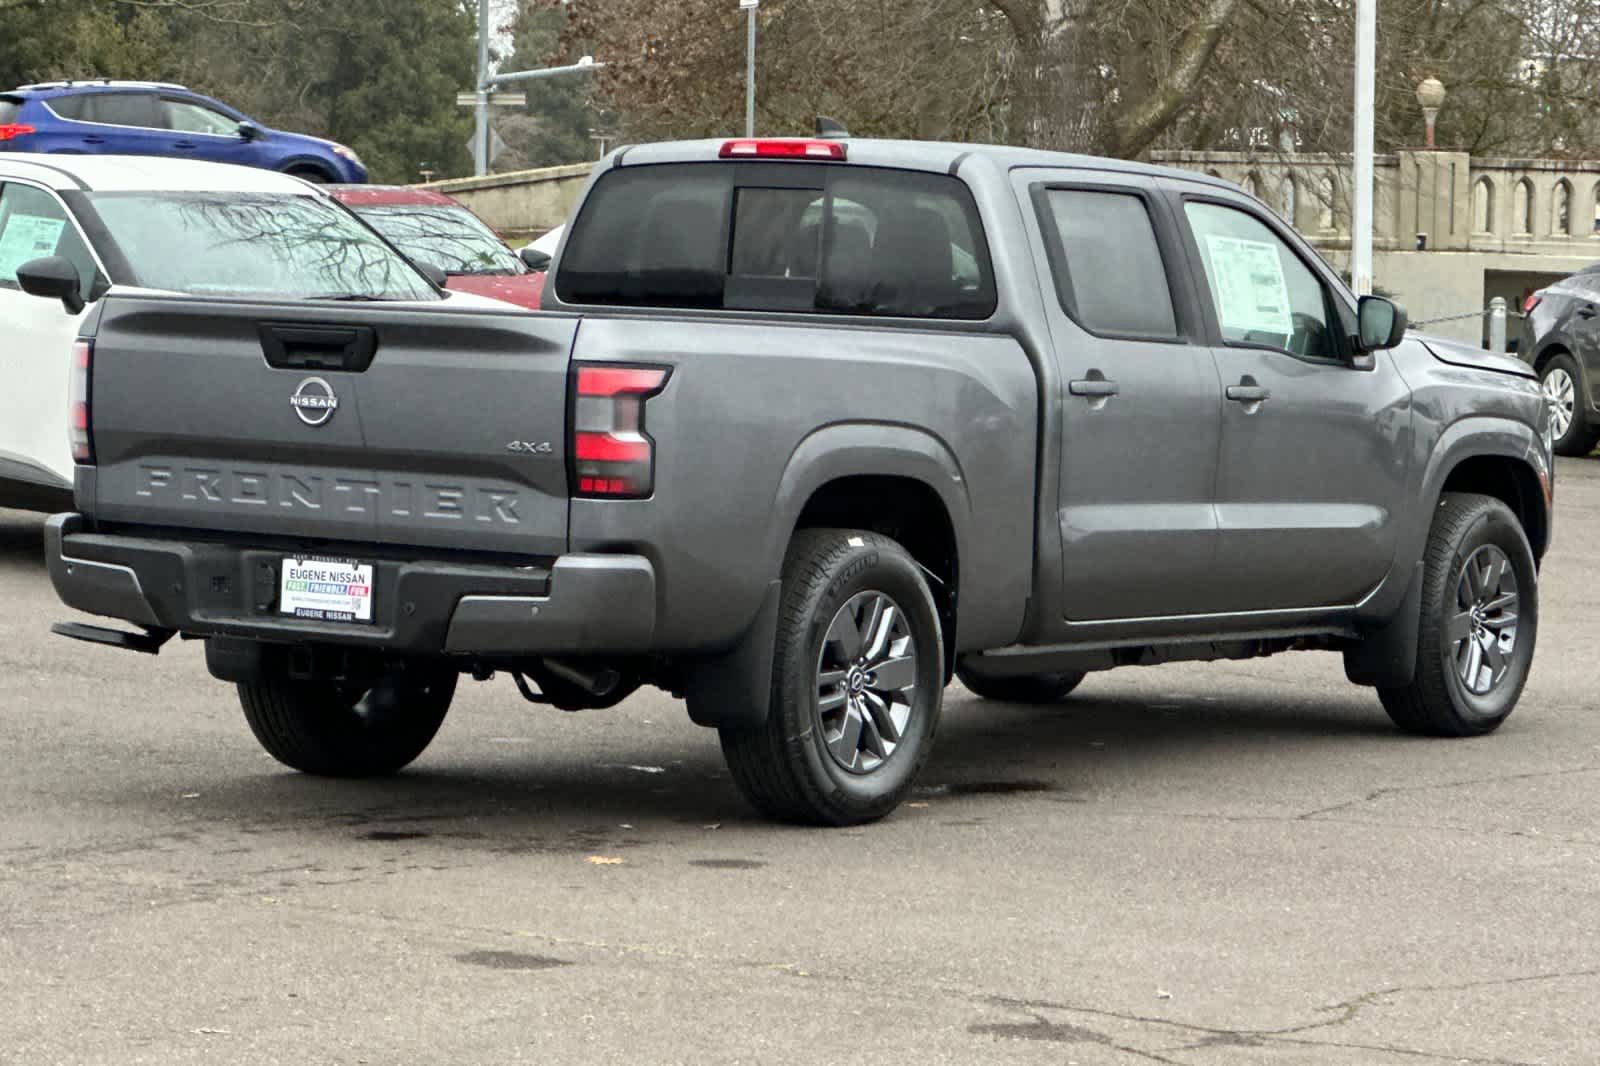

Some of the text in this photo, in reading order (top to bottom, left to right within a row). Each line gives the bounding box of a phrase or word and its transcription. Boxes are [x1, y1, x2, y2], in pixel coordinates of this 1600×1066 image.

[290, 396, 338, 409] NISSAN
[135, 464, 521, 525] FRONTIER
[290, 568, 365, 585] EUGENE NISSAN
[296, 608, 352, 621] EUGENE NISSAN
